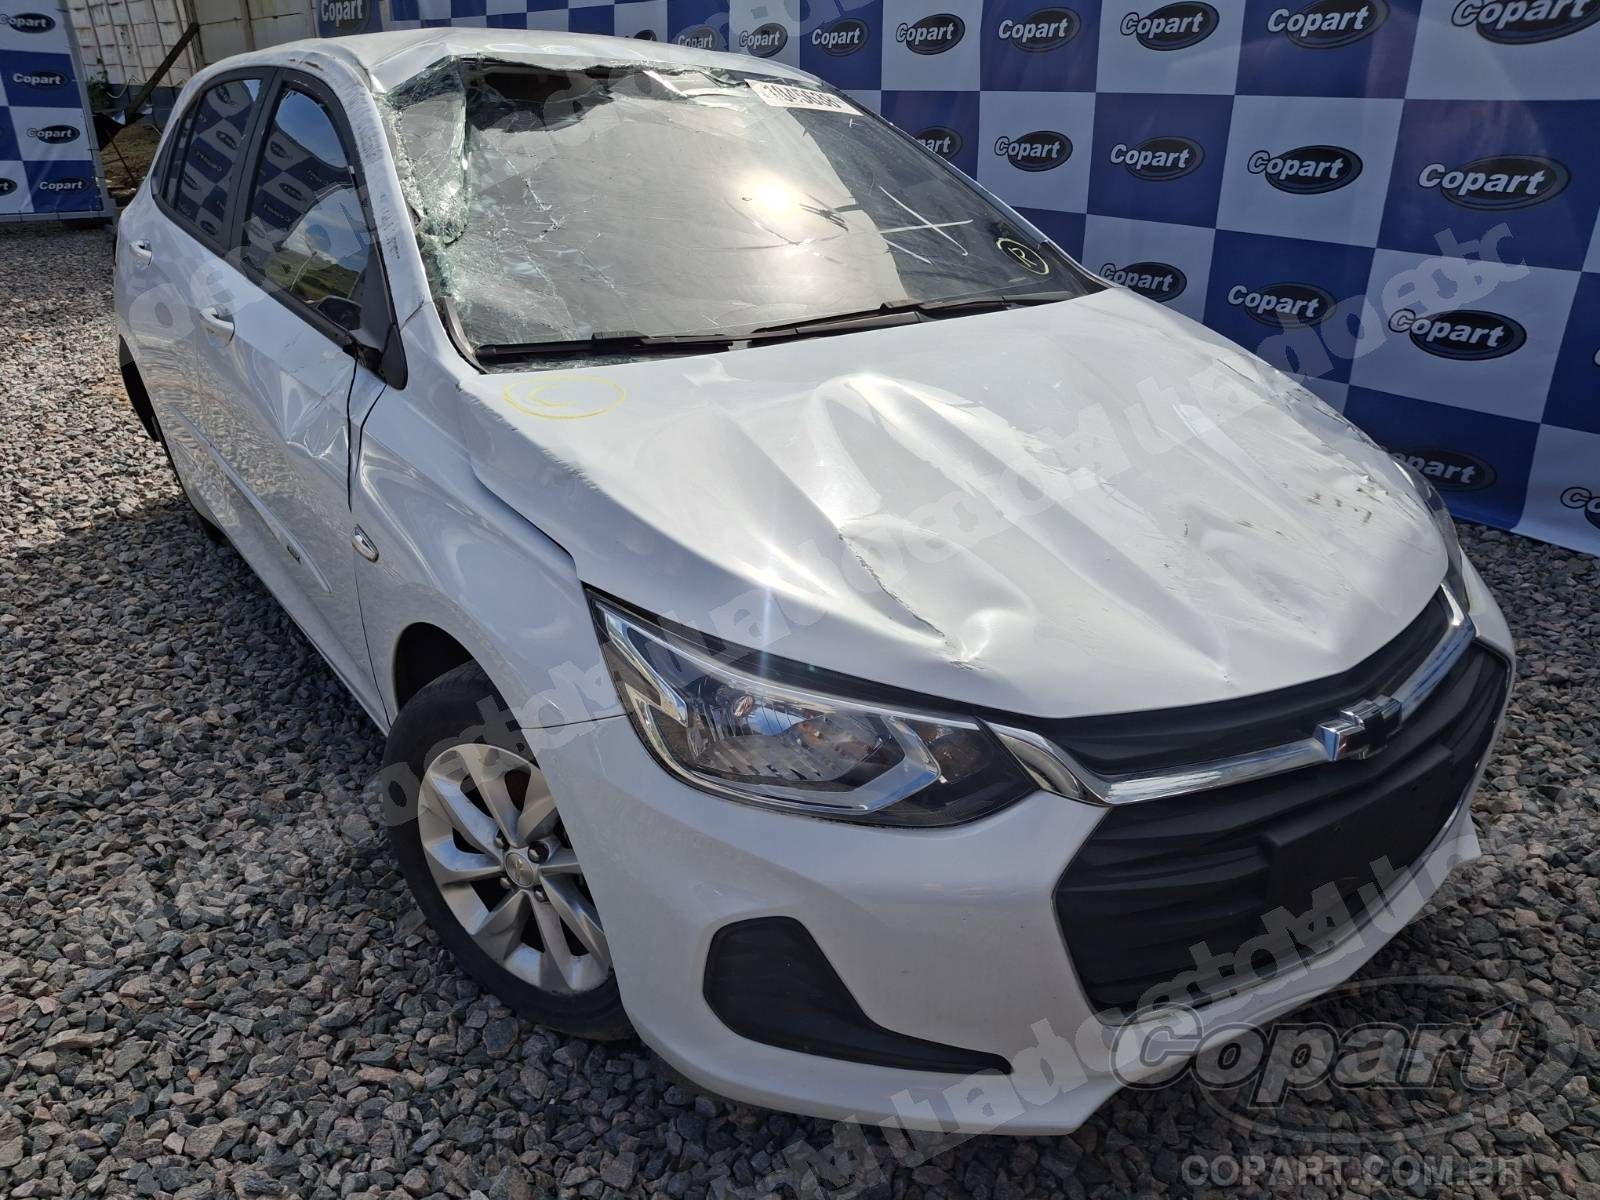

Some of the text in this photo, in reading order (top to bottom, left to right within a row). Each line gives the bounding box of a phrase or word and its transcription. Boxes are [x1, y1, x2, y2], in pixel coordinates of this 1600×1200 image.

[320, 0, 363, 27] Copart
[1120, 11, 1203, 38] Copart
[1267, 5, 1369, 37] Copart
[1451, 0, 1586, 30] Copart
[739, 31, 780, 49] Copart
[811, 25, 860, 46] Copart
[896, 20, 954, 45] Copart
[999, 17, 1068, 42] Copart
[12, 72, 62, 86] Copart
[27, 128, 72, 139] Copart
[995, 136, 1061, 159] Copart
[1110, 144, 1190, 170] Copart
[1247, 150, 1345, 180] Copart
[39, 181, 82, 191] Copart
[1418, 163, 1546, 196] Copart
[1100, 262, 1174, 292] Copart
[1227, 284, 1320, 318] Copart
[1388, 308, 1505, 348] Copart
